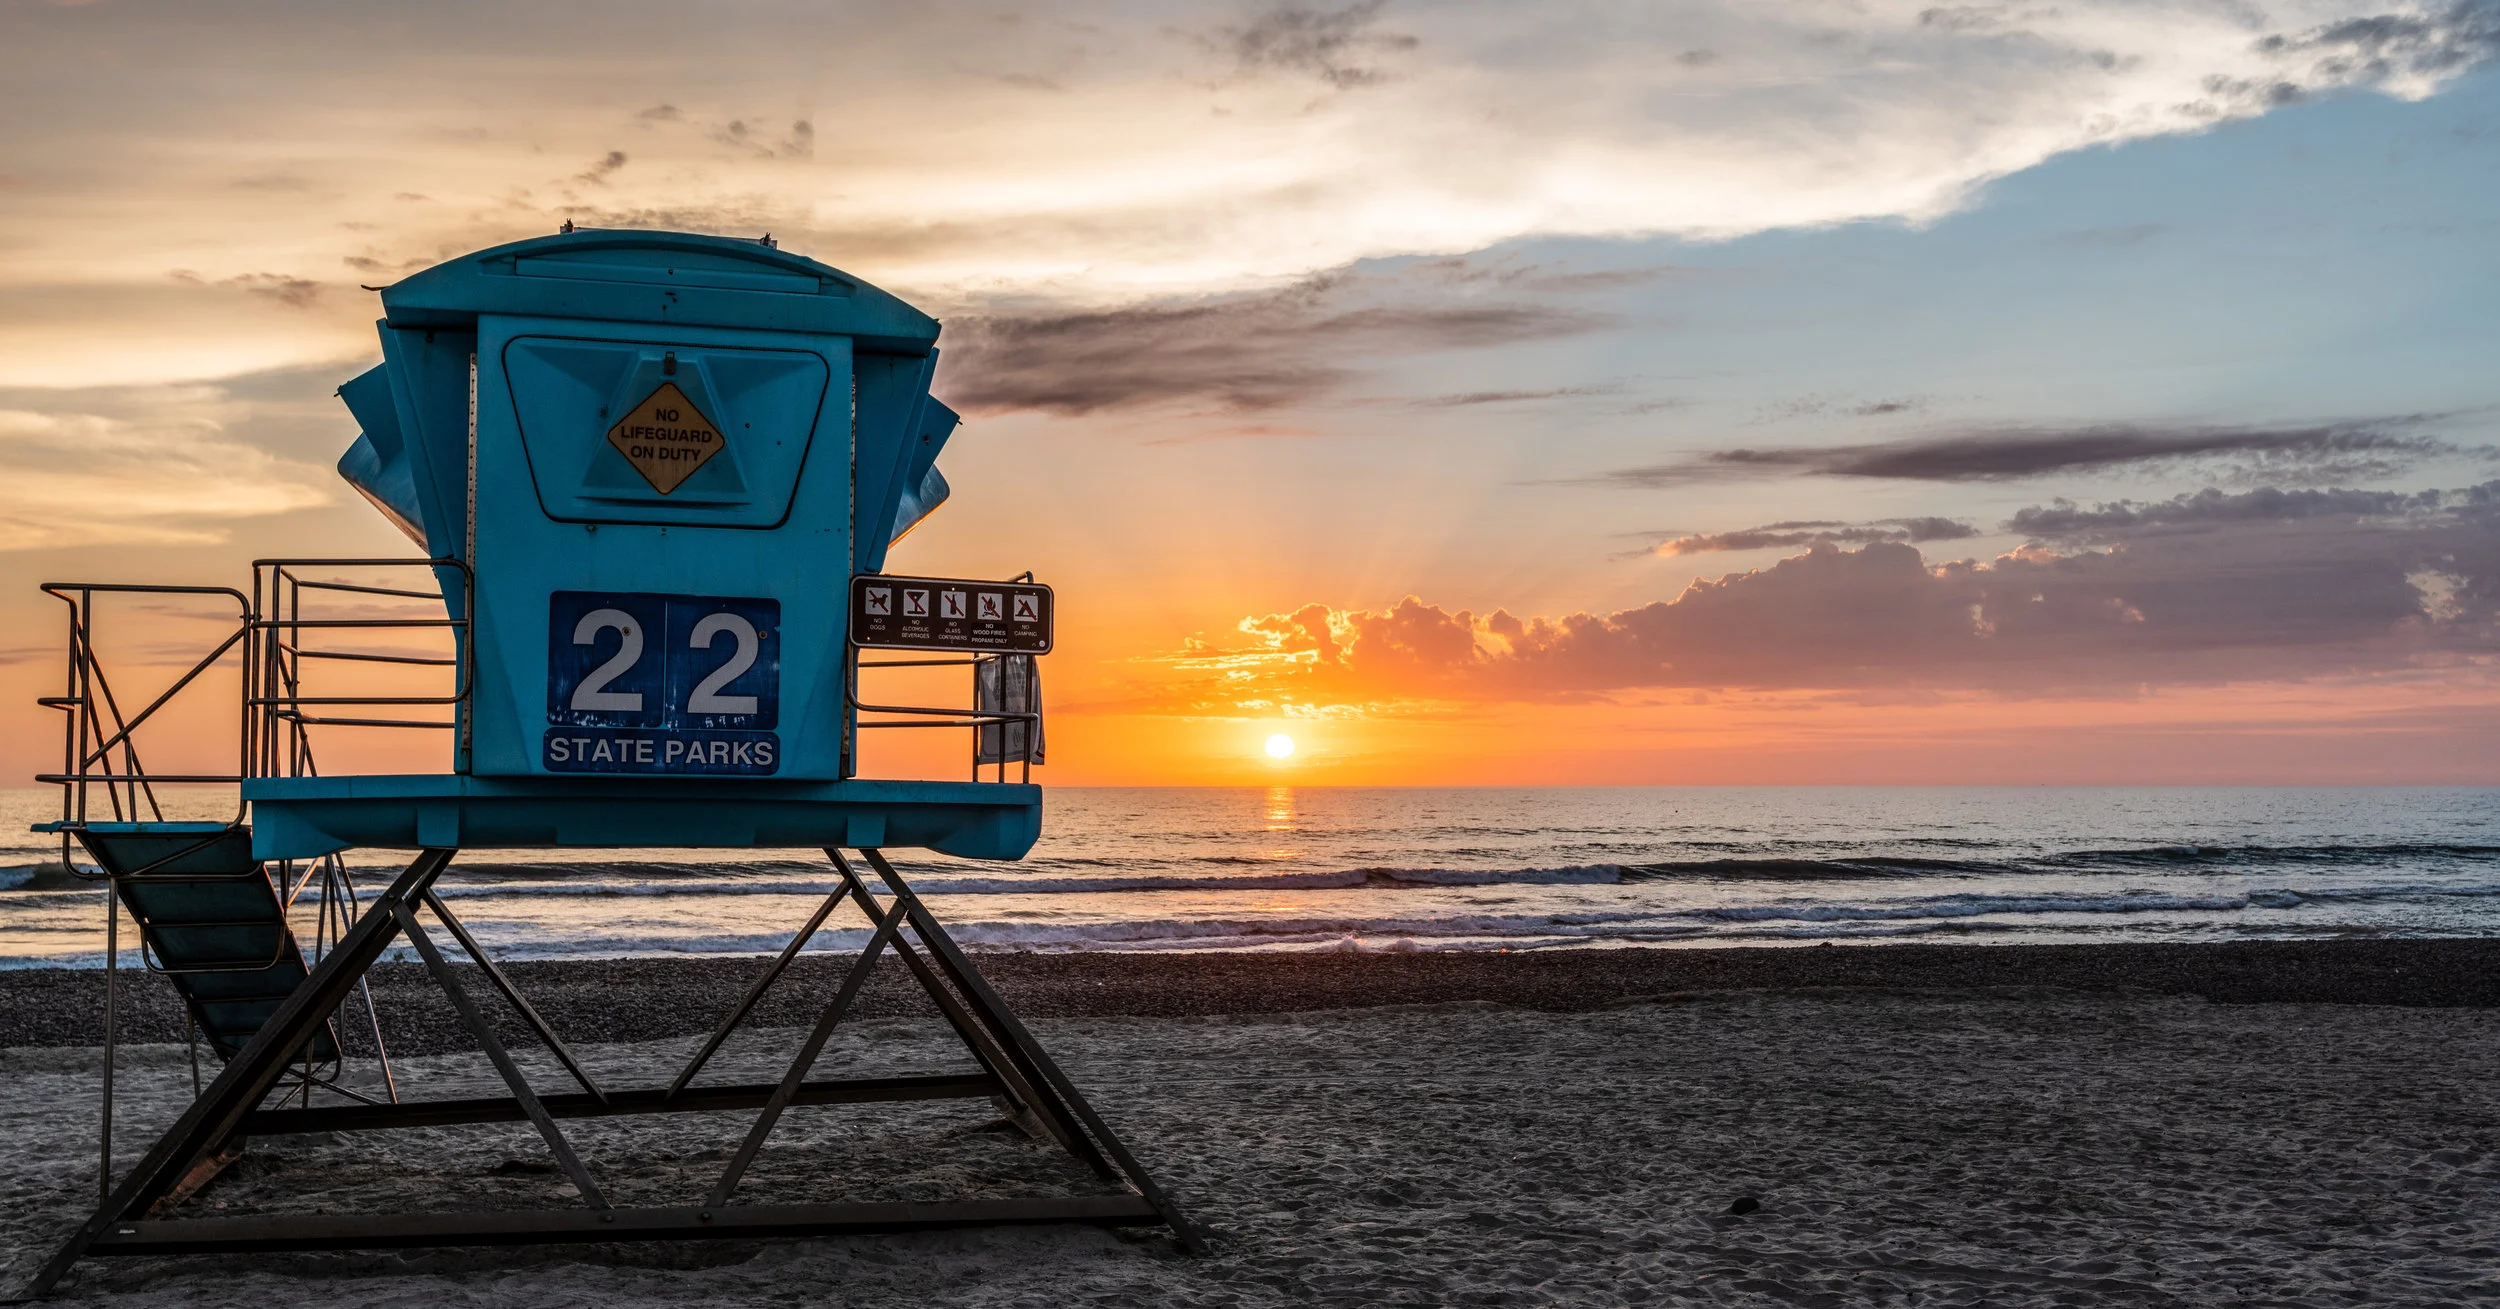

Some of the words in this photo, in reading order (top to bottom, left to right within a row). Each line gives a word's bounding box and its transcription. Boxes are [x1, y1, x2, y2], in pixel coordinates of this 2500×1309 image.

[655, 408, 679, 422] NO
[620, 426, 712, 443] LIFEGUARD
[630, 445, 653, 460] ON
[659, 447, 701, 461] DUTY
[550, 737, 654, 763] STATE
[665, 740, 773, 766] PARKS
